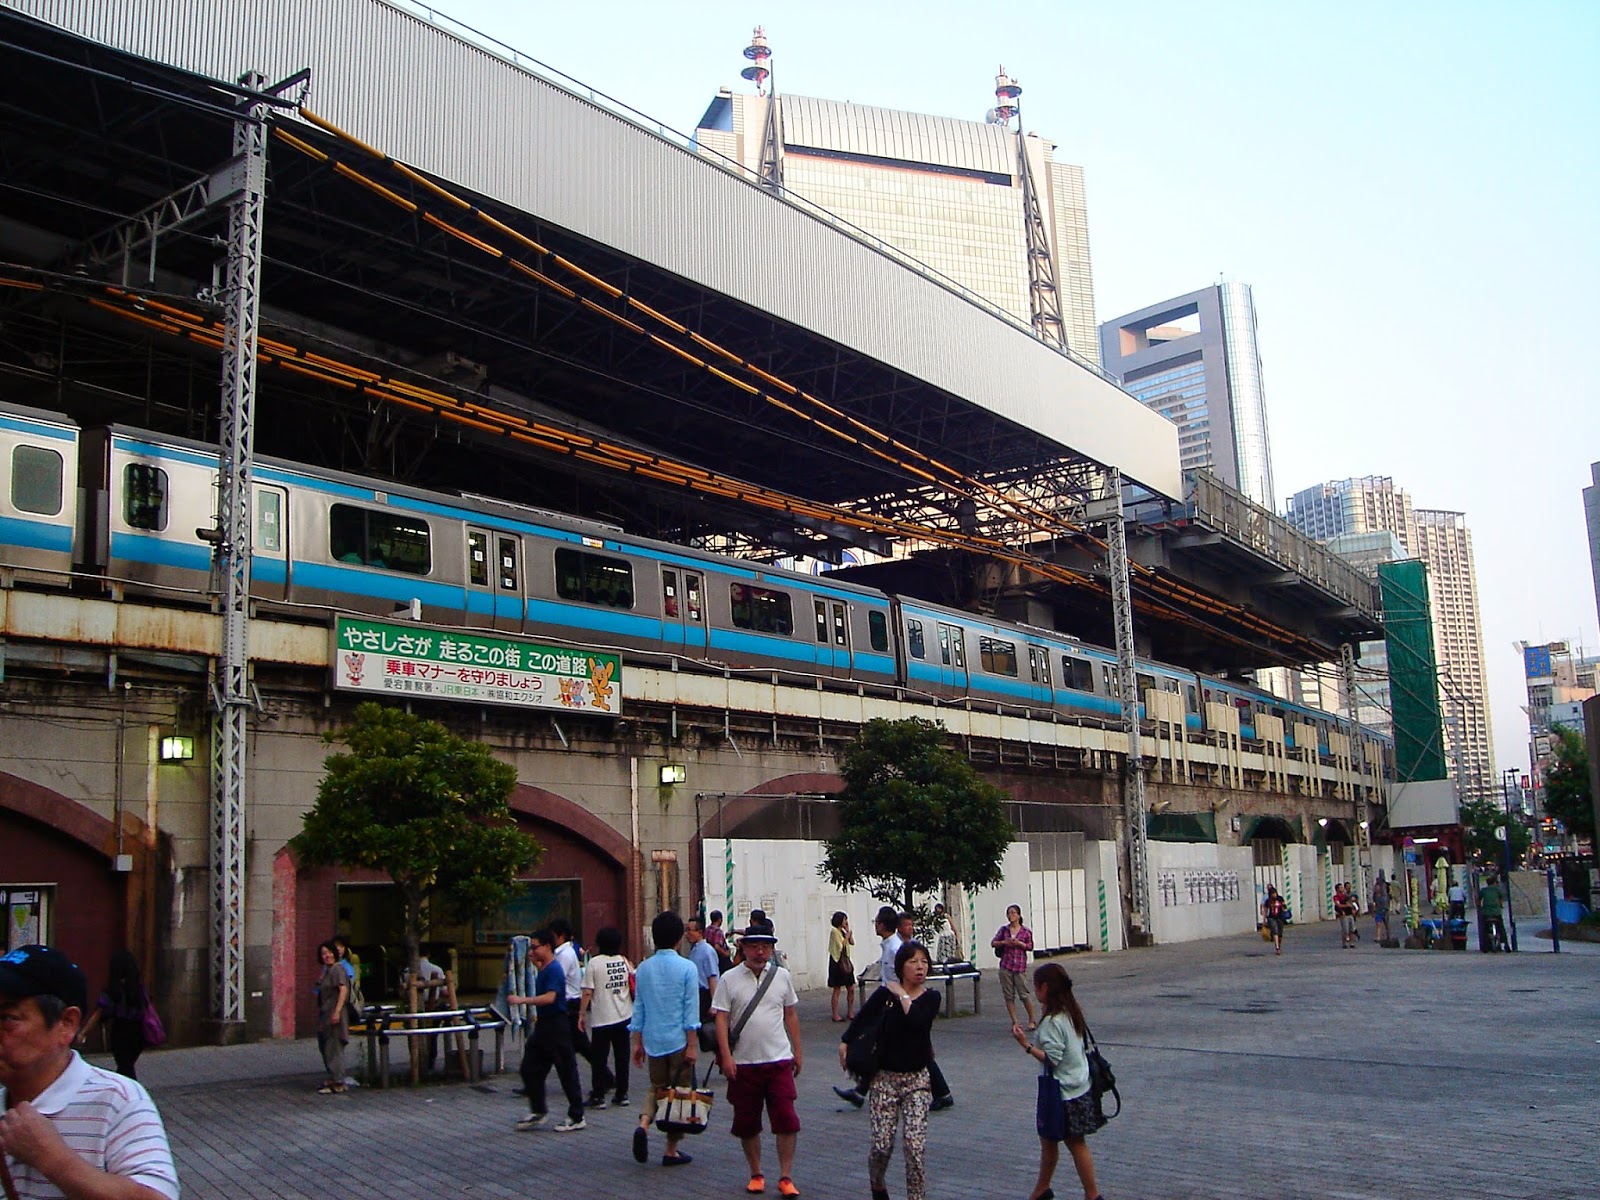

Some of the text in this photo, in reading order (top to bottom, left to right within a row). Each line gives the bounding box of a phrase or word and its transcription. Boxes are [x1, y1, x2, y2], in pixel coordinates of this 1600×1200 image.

[343, 626, 588, 676] やさしさが 走るこの街 この道路
[386, 658, 543, 691] 乗車マナーを守りましょう
